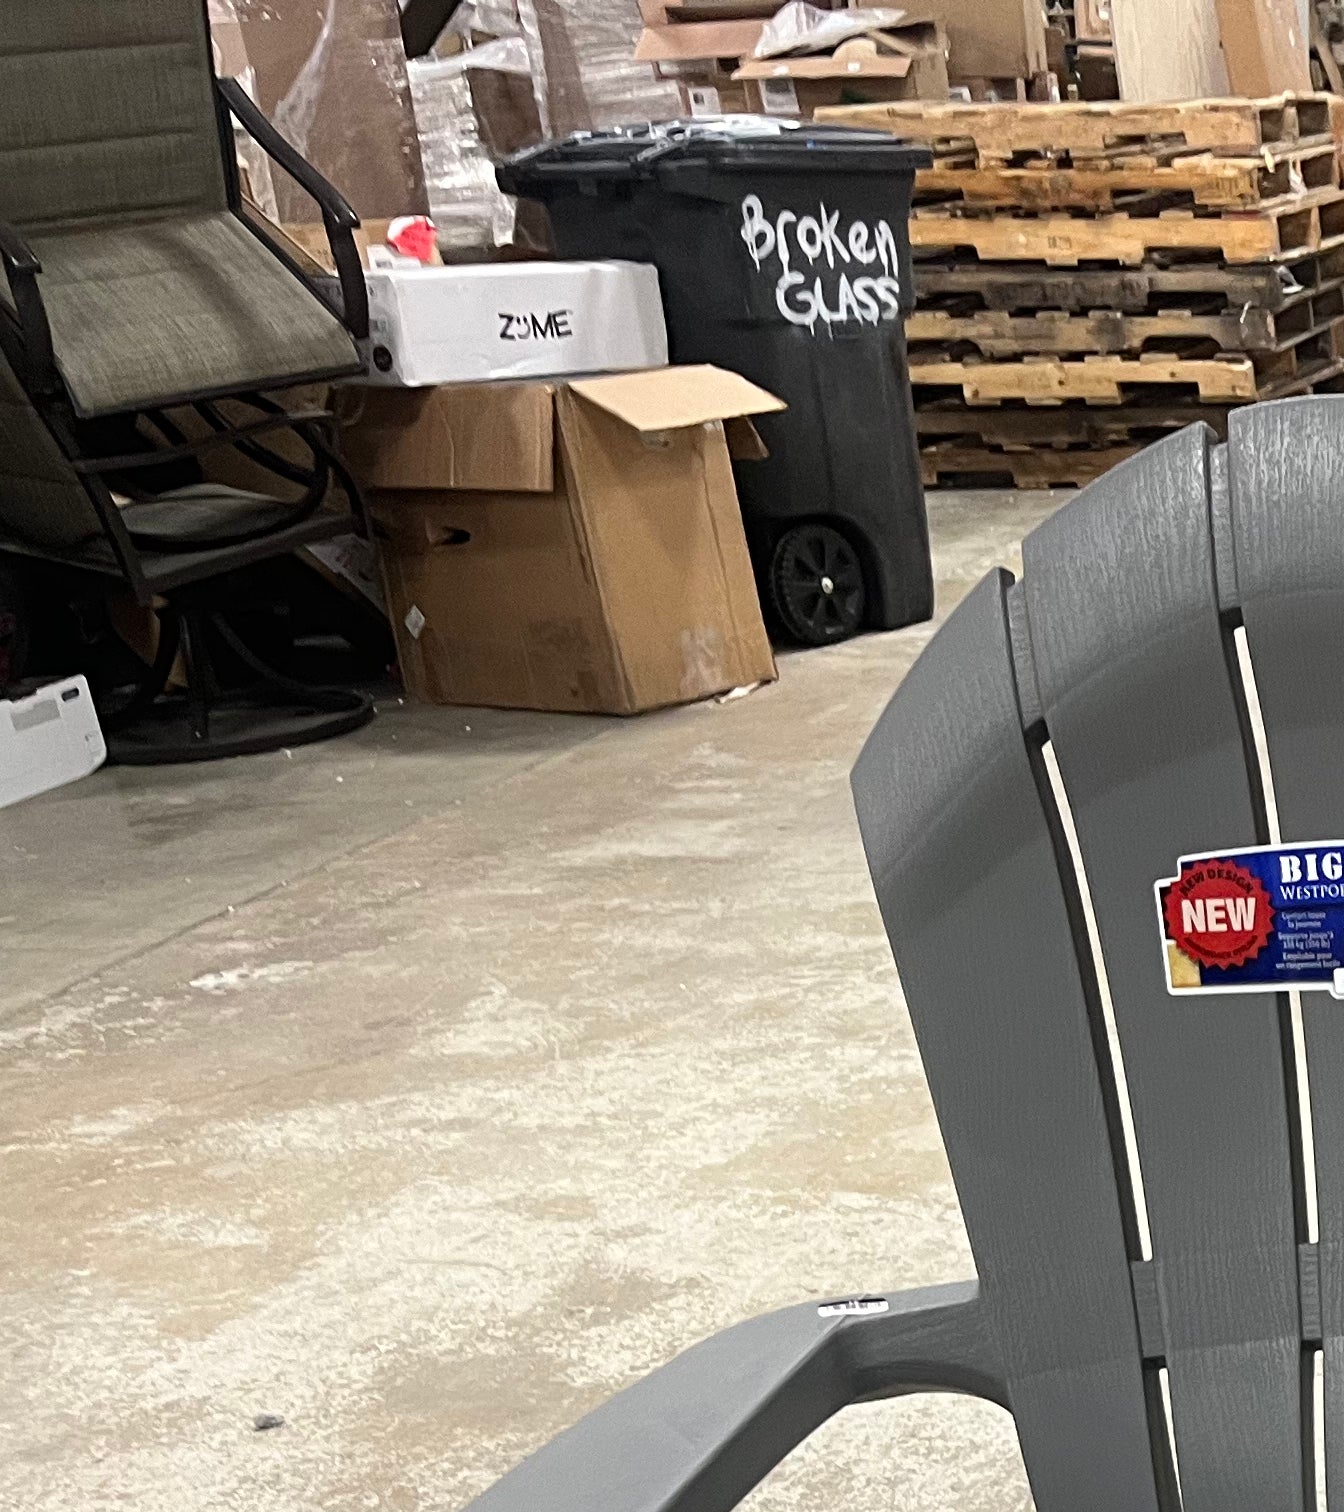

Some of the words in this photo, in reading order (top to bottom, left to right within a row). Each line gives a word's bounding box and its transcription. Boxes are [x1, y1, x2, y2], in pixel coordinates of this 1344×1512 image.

[740, 193, 899, 277] Broken
[775, 271, 899, 332] GLASS
[1279, 852, 1343, 883] BIG
[1181, 897, 1256, 934] NEW
